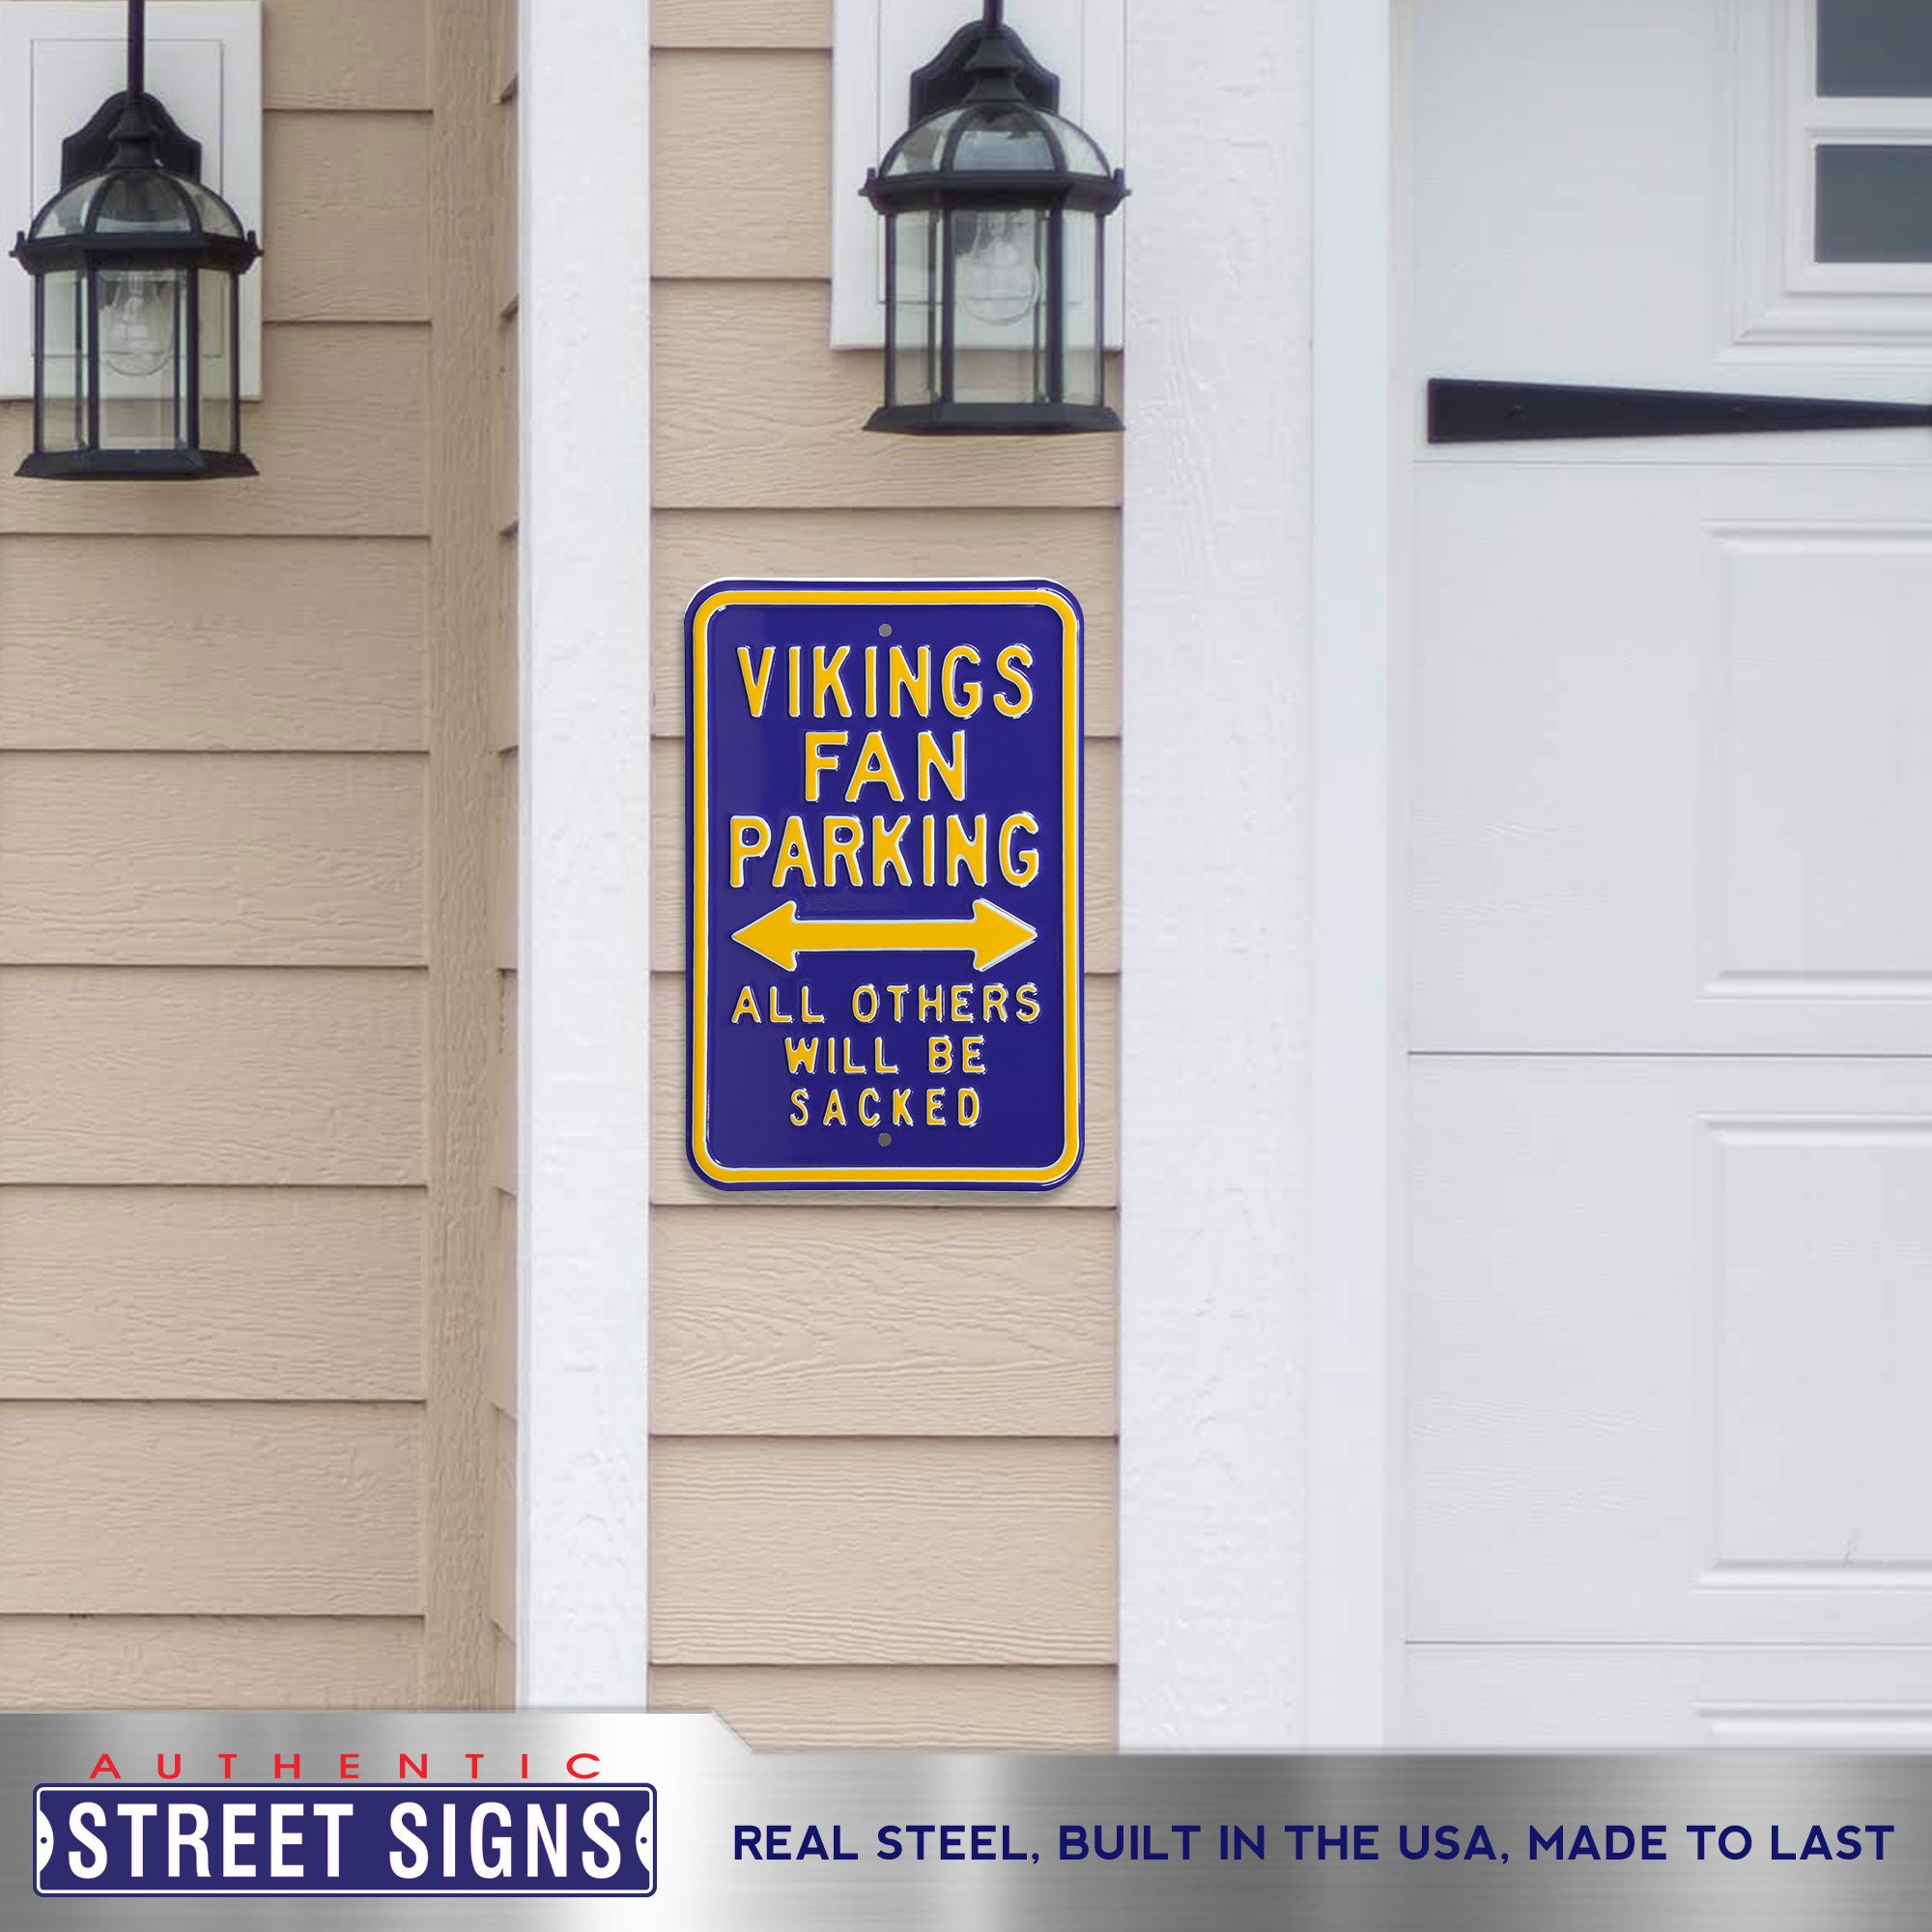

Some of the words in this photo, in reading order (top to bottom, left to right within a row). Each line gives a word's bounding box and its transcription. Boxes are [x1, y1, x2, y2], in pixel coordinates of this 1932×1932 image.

[736, 642, 1034, 721] VIKINGS
[805, 729, 966, 803] FAN
[729, 810, 1039, 889] PARKING
[731, 985, 825, 1025] ALL
[852, 981, 1041, 1024] OTHERS
[784, 1037, 899, 1075] WILL
[928, 1035, 986, 1075] BE
[789, 1087, 980, 1128] SACKED
